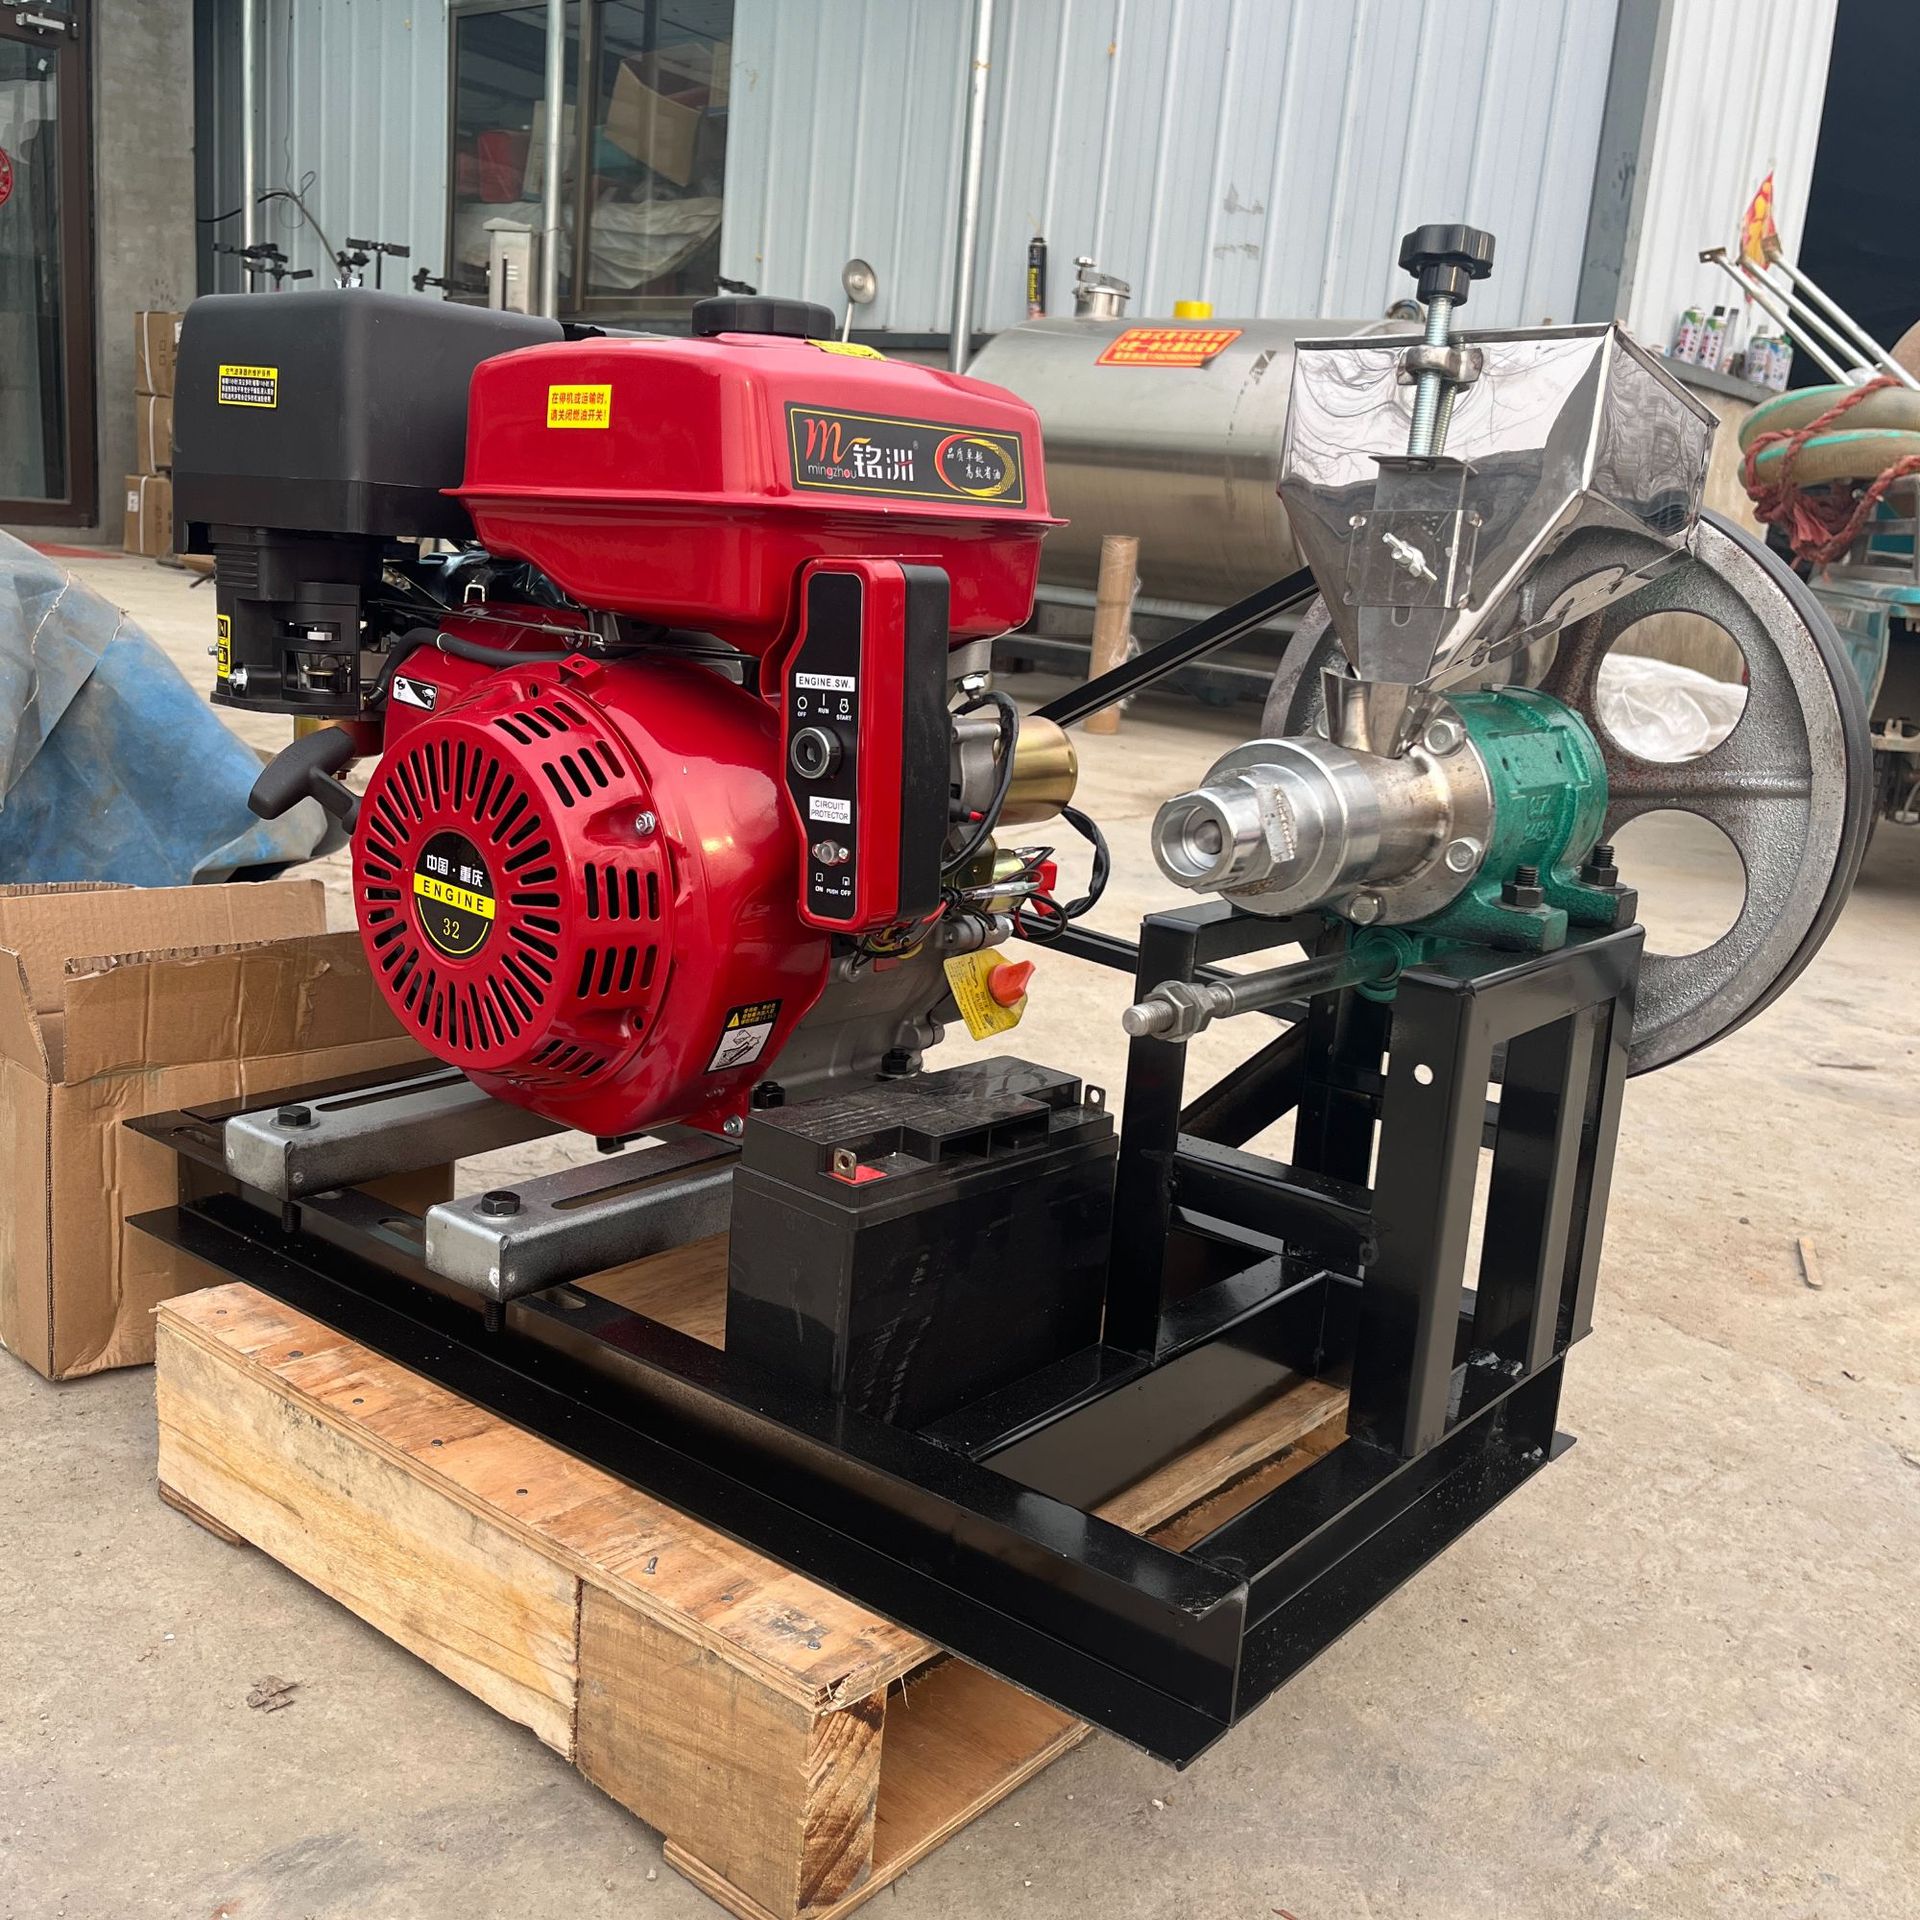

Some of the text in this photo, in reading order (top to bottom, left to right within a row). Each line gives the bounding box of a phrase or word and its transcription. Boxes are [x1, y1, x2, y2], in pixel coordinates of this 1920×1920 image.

[808, 463, 857, 479] mingzhou
[853, 443, 914, 481] 铭洲
[811, 809, 849, 820] PROTECTOR
[815, 800, 844, 810] CIRCUIT
[423, 880, 484, 912] ENGINE
[443, 917, 460, 940] 32
